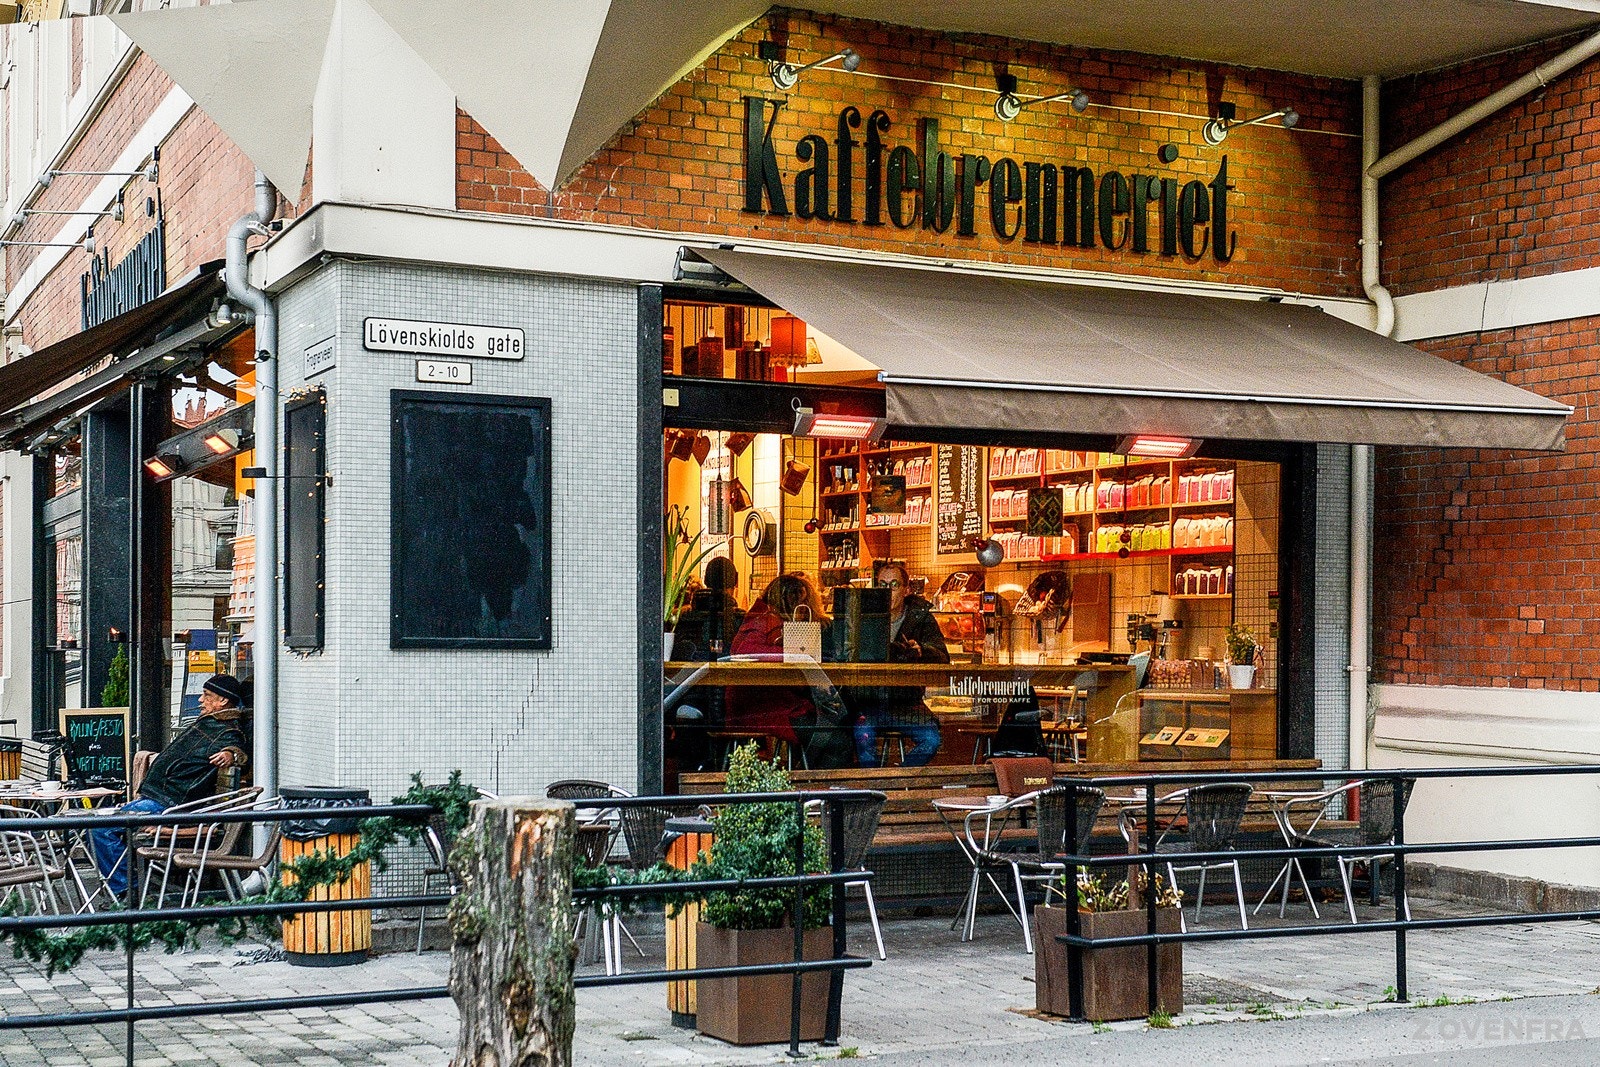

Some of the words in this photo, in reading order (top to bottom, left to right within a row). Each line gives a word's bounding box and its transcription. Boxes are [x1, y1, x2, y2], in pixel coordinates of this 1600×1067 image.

[741, 96, 1237, 262] Kaffebrenneriet
[369, 323, 475, 350] Lövenskiolds
[487, 334, 520, 355] gate
[949, 676, 1031, 696] Kaffebrenneriet
